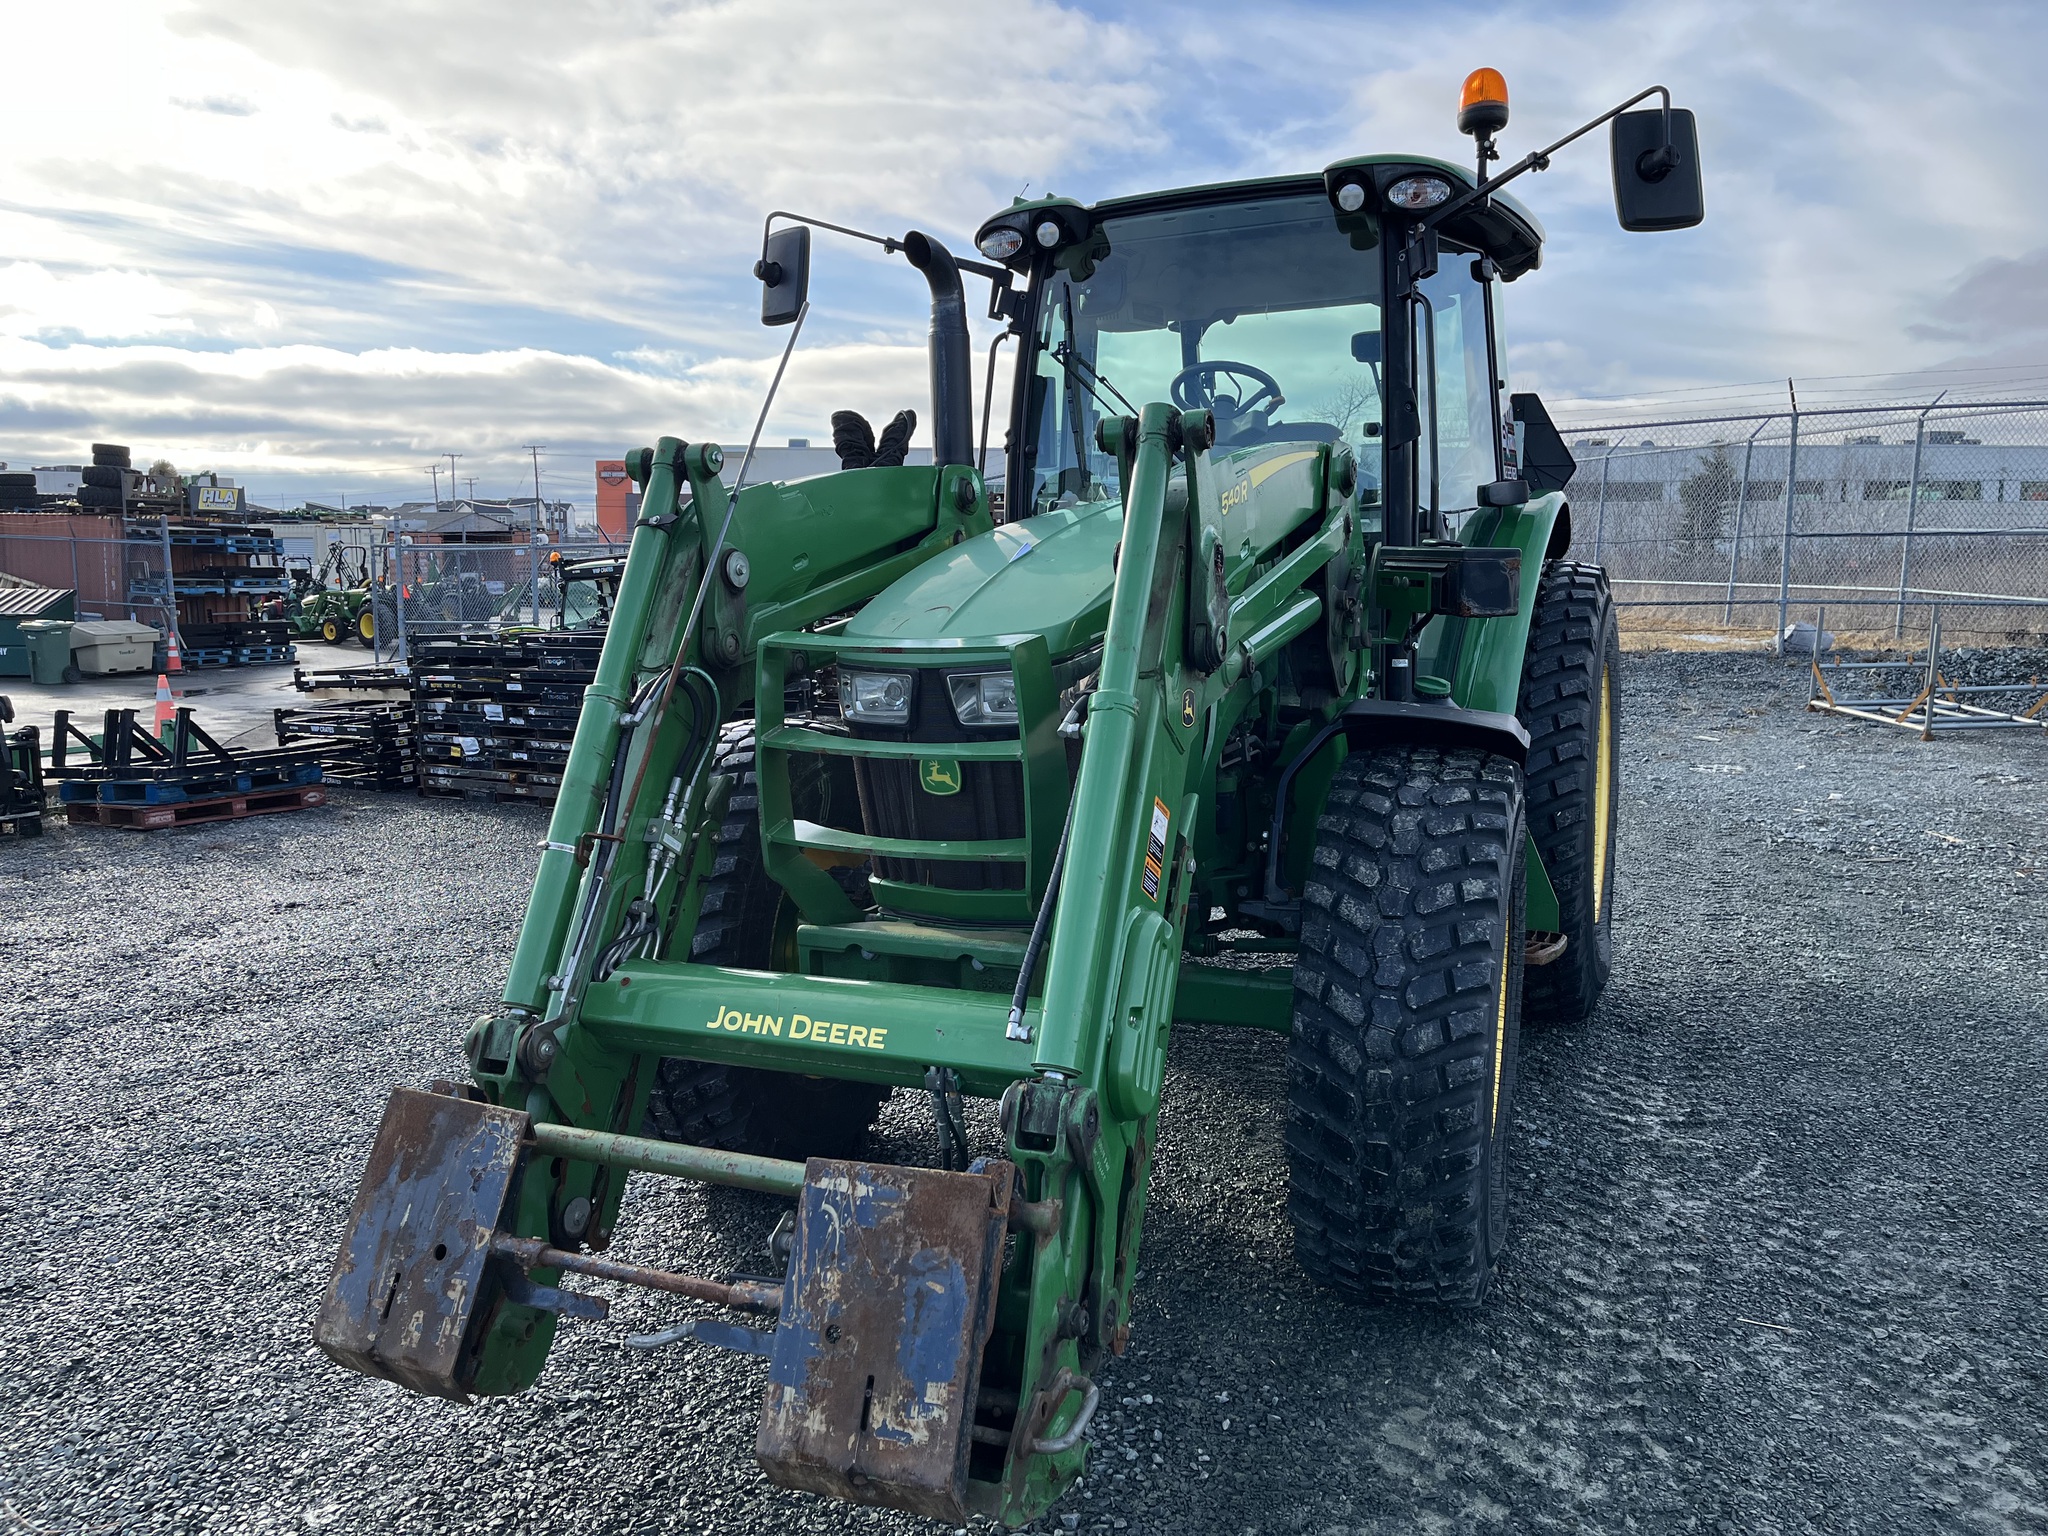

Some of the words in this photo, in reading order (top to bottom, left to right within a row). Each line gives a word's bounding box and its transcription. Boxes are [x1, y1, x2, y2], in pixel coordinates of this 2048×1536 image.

[202, 489, 235, 503] HLA
[1221, 484, 1240, 516] 540
[1241, 479, 1248, 504] R
[706, 1005, 784, 1037] JOHN
[788, 1014, 888, 1050] DEERE
